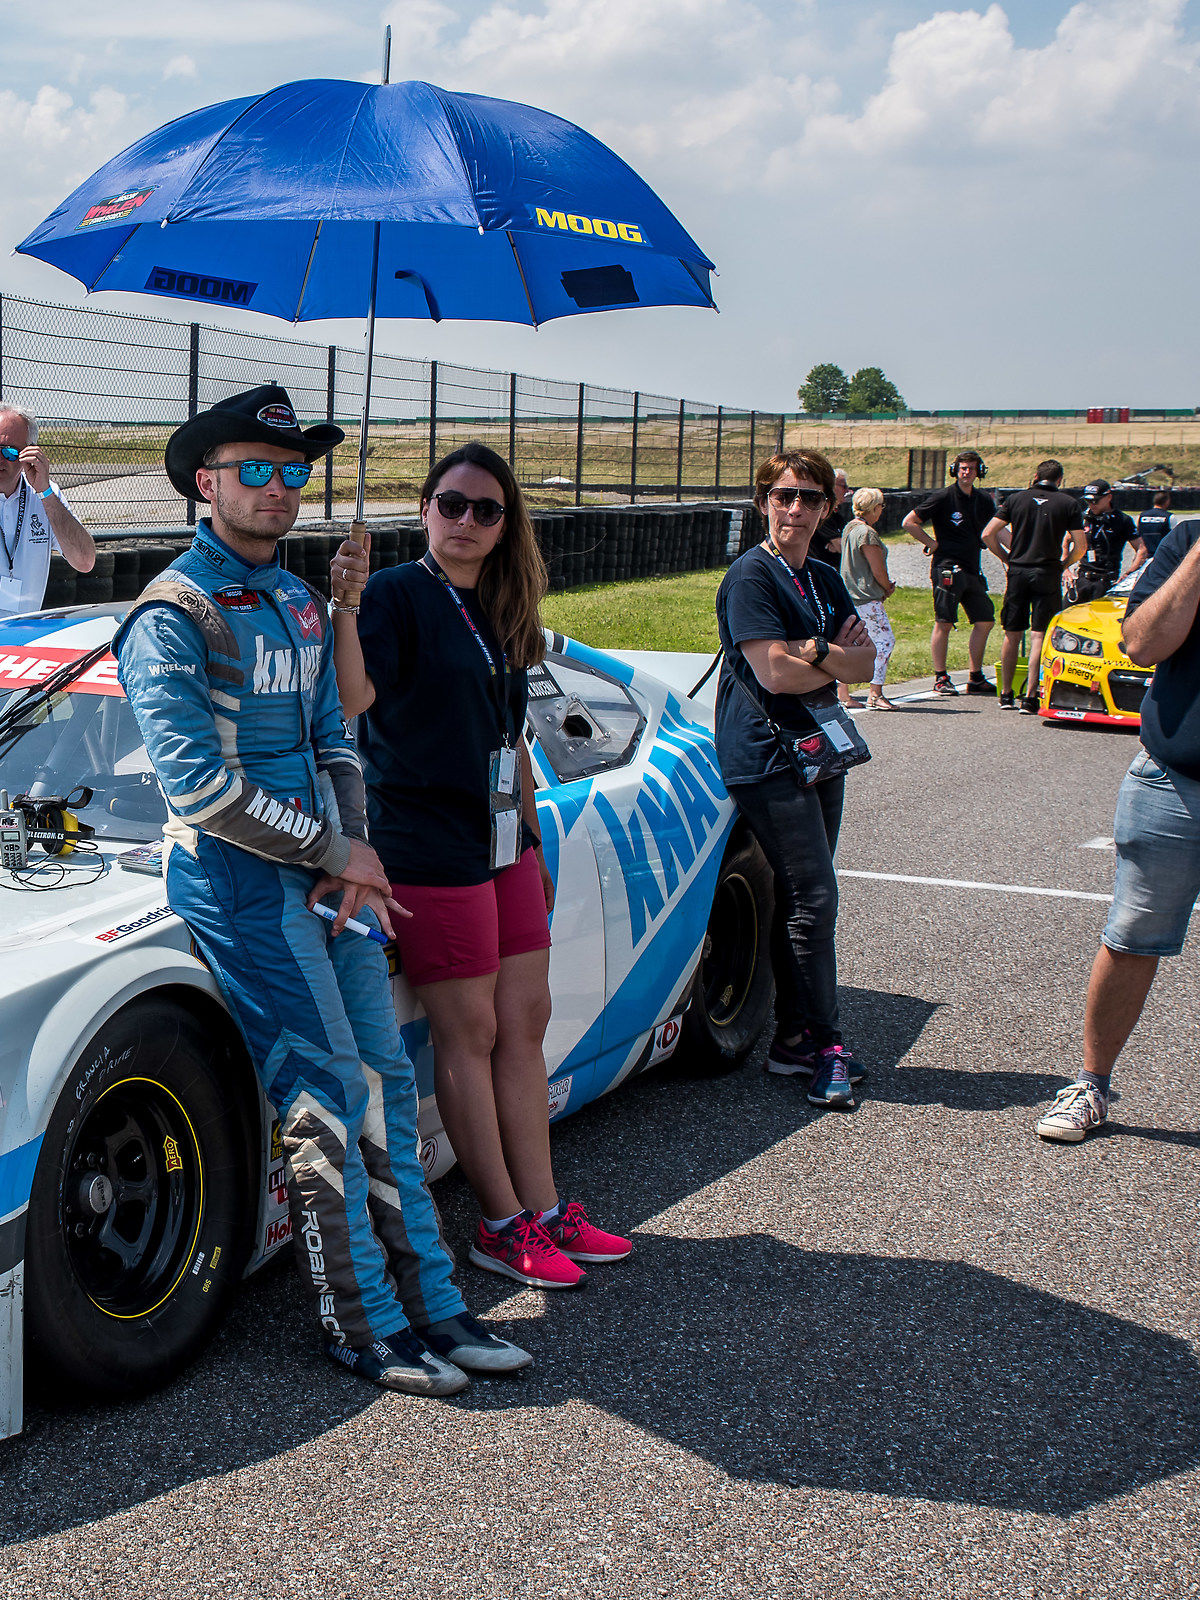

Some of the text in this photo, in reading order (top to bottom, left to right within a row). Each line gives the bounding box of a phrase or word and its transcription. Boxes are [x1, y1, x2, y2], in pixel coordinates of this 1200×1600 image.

[535, 207, 642, 243] MOOG
[1067, 666, 1096, 681] energy
[1070, 660, 1102, 673] comfort
[245, 787, 322, 849] KNAUF
[166, 1141, 178, 1166] AERO
